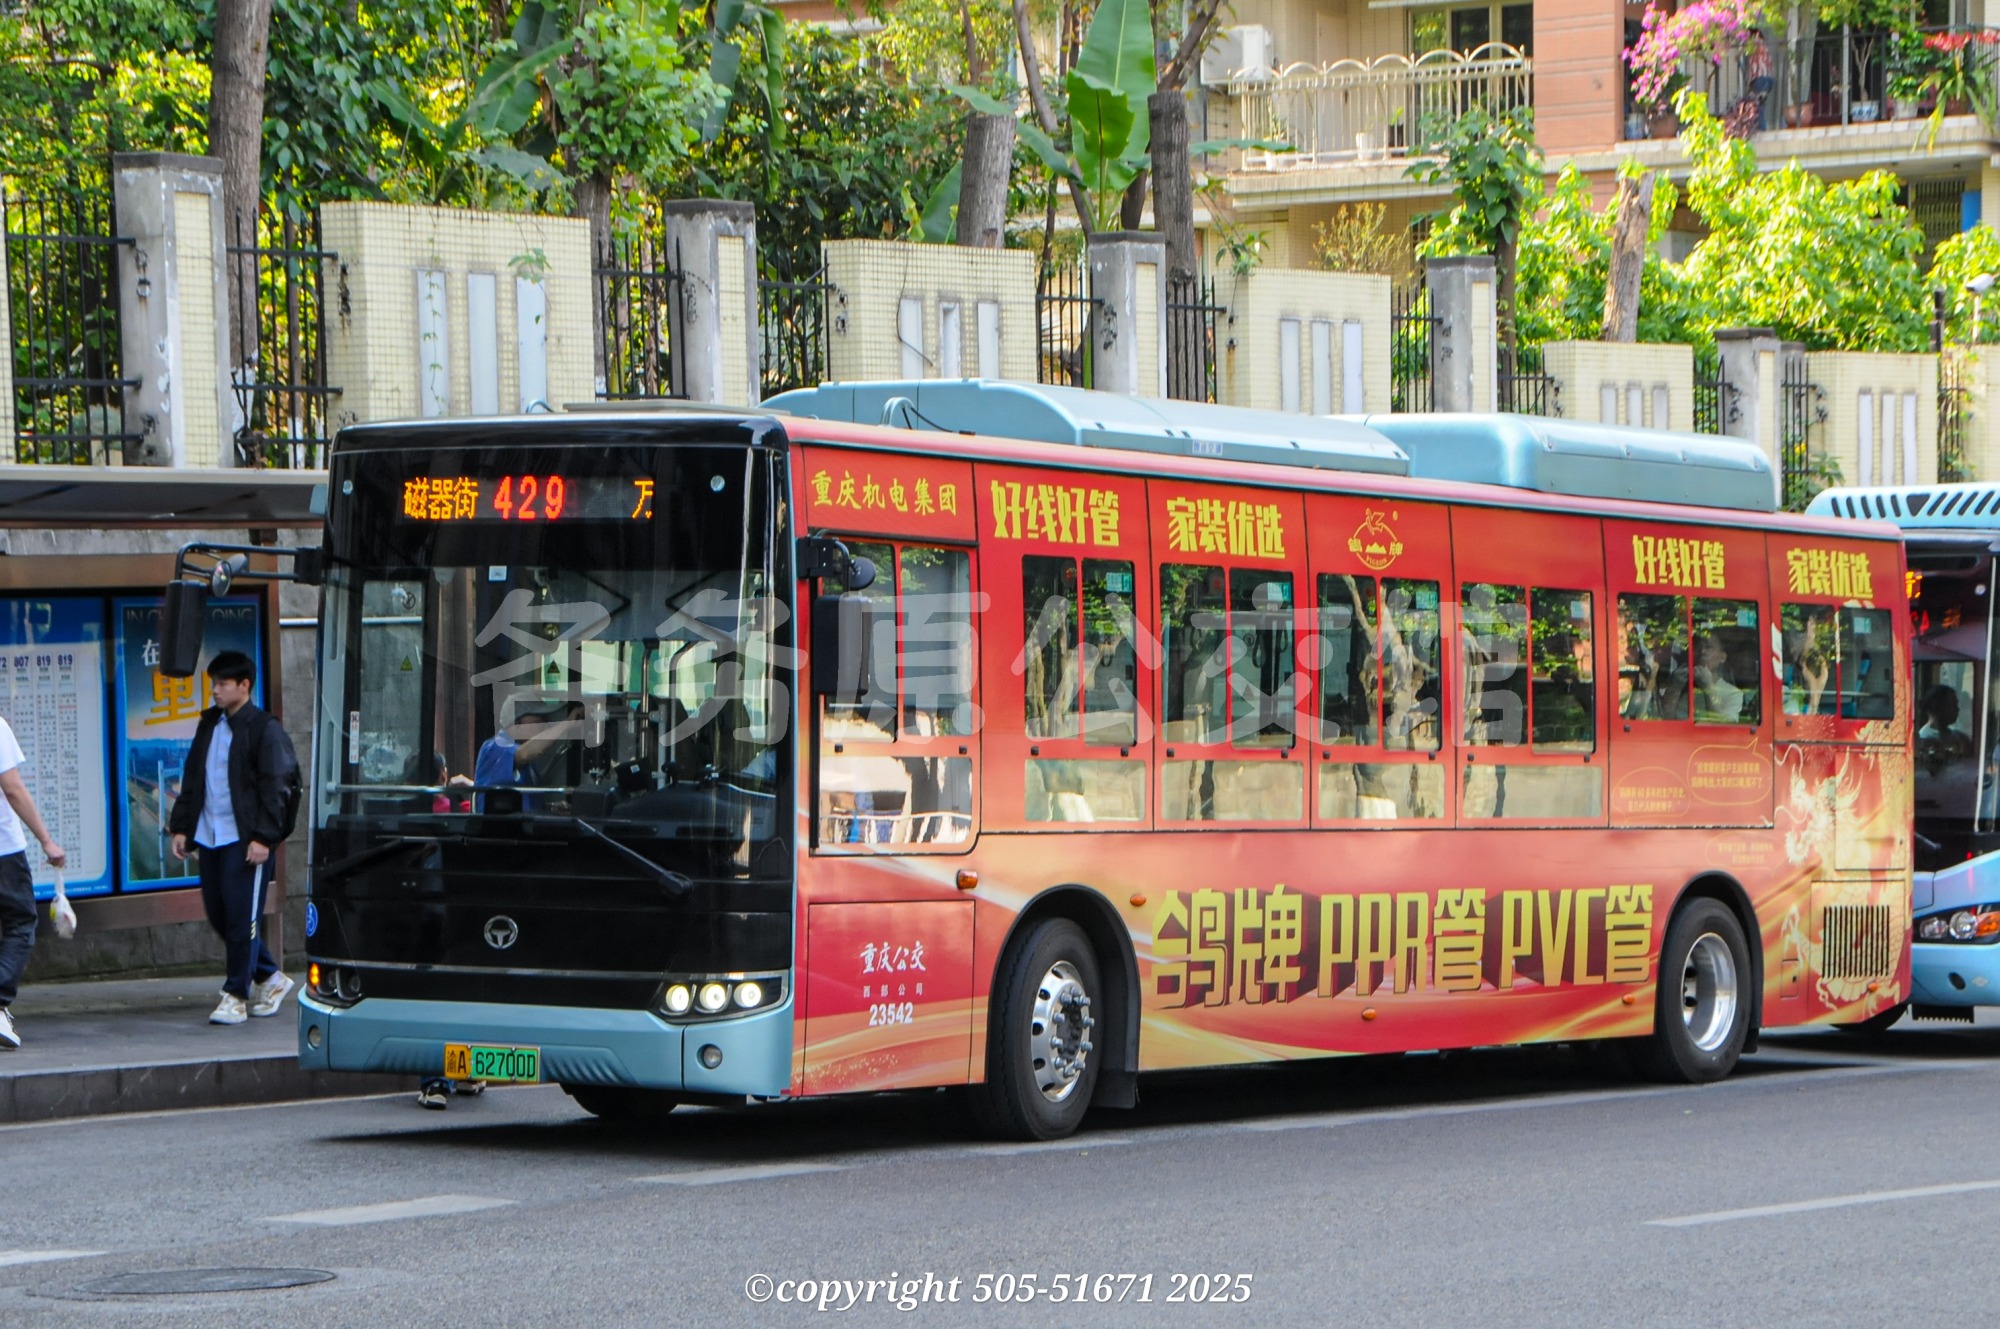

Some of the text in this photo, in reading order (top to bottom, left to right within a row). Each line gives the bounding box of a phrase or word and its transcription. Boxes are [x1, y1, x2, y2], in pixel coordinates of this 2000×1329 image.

[404, 477, 479, 519] 磁器街
[494, 475, 565, 519] 429
[811, 470, 957, 516] 重庆机电集团
[991, 480, 1120, 547] 好线好管
[1167, 497, 1286, 559] 家装优选
[1632, 535, 1726, 590] 好线好管
[1787, 548, 1874, 599] 家装优选
[14, 656, 29, 667] 807
[37, 655, 51, 666] 819
[58, 654, 73, 665] 819
[860, 940, 926, 974] 重庆公交
[1151, 884, 1653, 1007] 鸽牌 PPR管 PVC管
[863, 982, 923, 998] 西部公司
[869, 1002, 914, 1026] 23542
